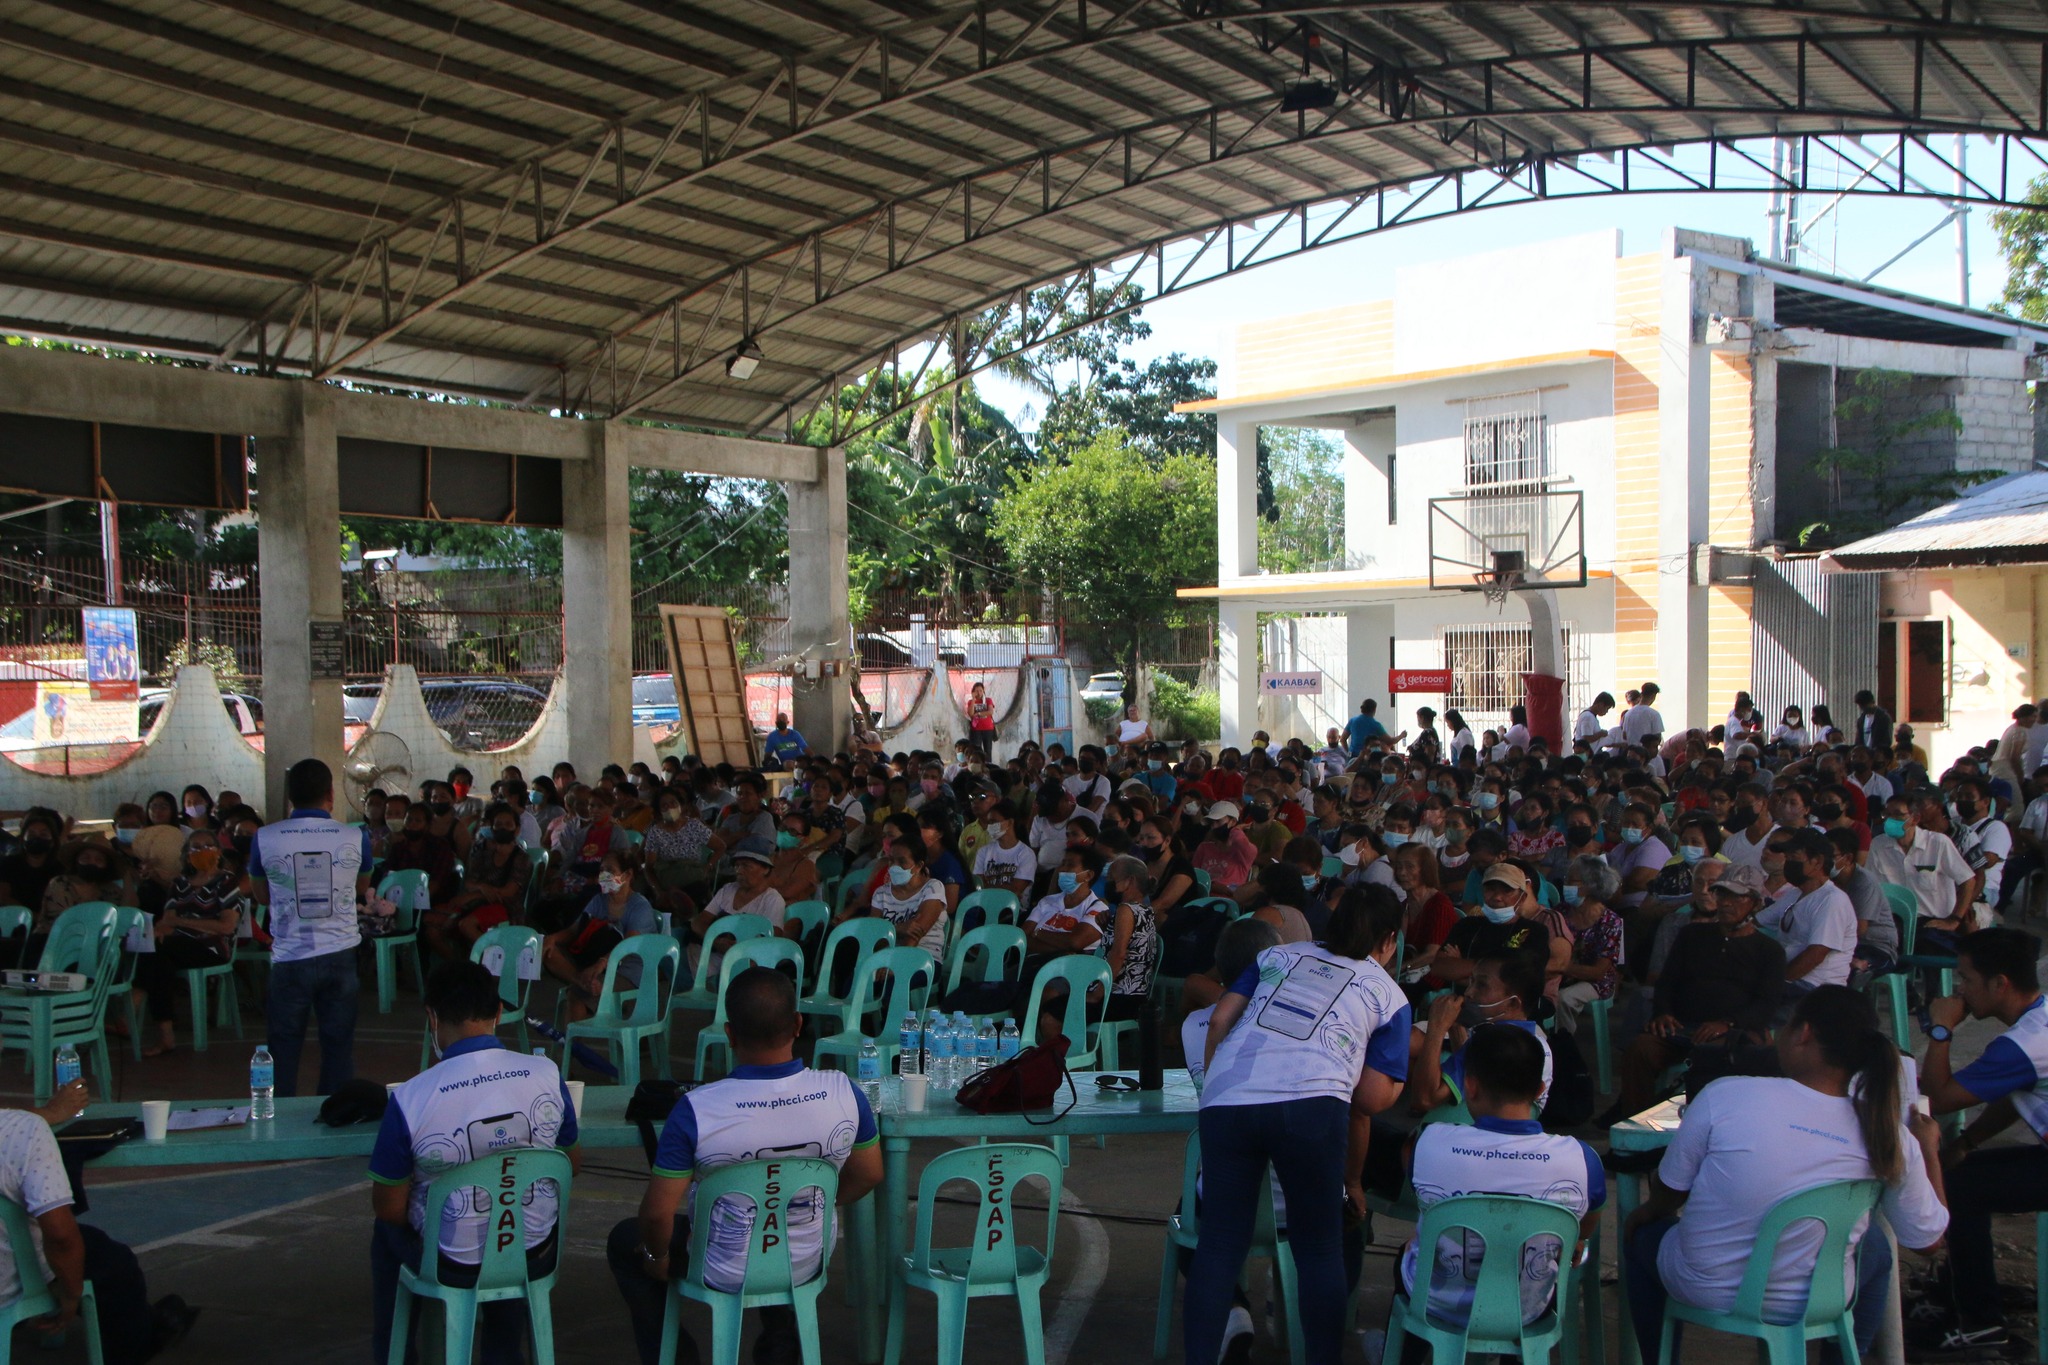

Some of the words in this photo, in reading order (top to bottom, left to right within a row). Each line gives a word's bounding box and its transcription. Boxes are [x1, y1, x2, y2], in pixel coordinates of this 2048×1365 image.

[1277, 678, 1317, 686] KAABAG
[280, 827, 340, 835] www.phcci.coop
[1308, 968, 1334, 980] PHCCI
[439, 1067, 531, 1094] www.phcci.coop
[735, 1089, 828, 1110] www.phcci.coop
[488, 1136, 517, 1149] PHCCI
[1789, 1124, 1849, 1144] www.phcci.coop
[1451, 1145, 1551, 1163] www.phcci.coop
[497, 1156, 517, 1253] FSCAP
[762, 1164, 781, 1254] FSCAP
[987, 1154, 1005, 1251] FSCAP
